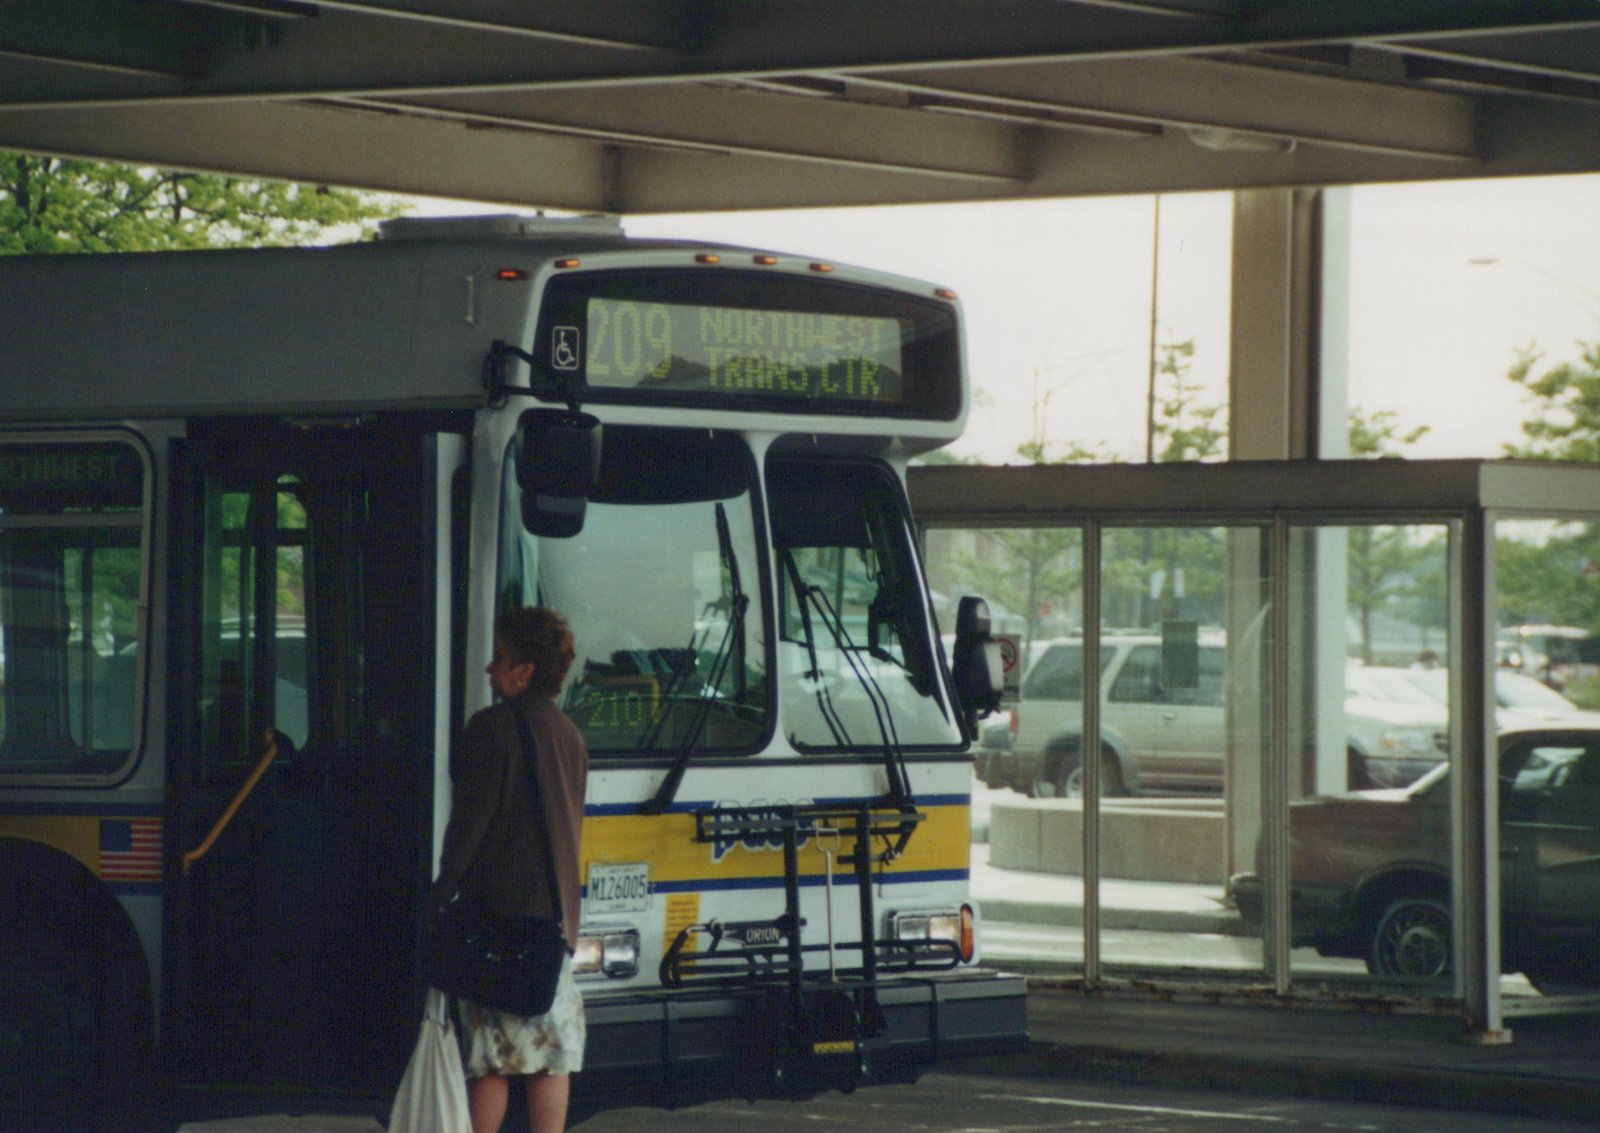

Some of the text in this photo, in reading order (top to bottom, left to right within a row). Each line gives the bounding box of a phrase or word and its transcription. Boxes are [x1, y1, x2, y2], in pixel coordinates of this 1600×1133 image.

[586, 300, 885, 378] 209 NORTHWEST
[703, 347, 880, 396] TRANS CTR
[587, 691, 643, 727] 210
[591, 874, 646, 901] M126005
[745, 928, 781, 943] ORION
